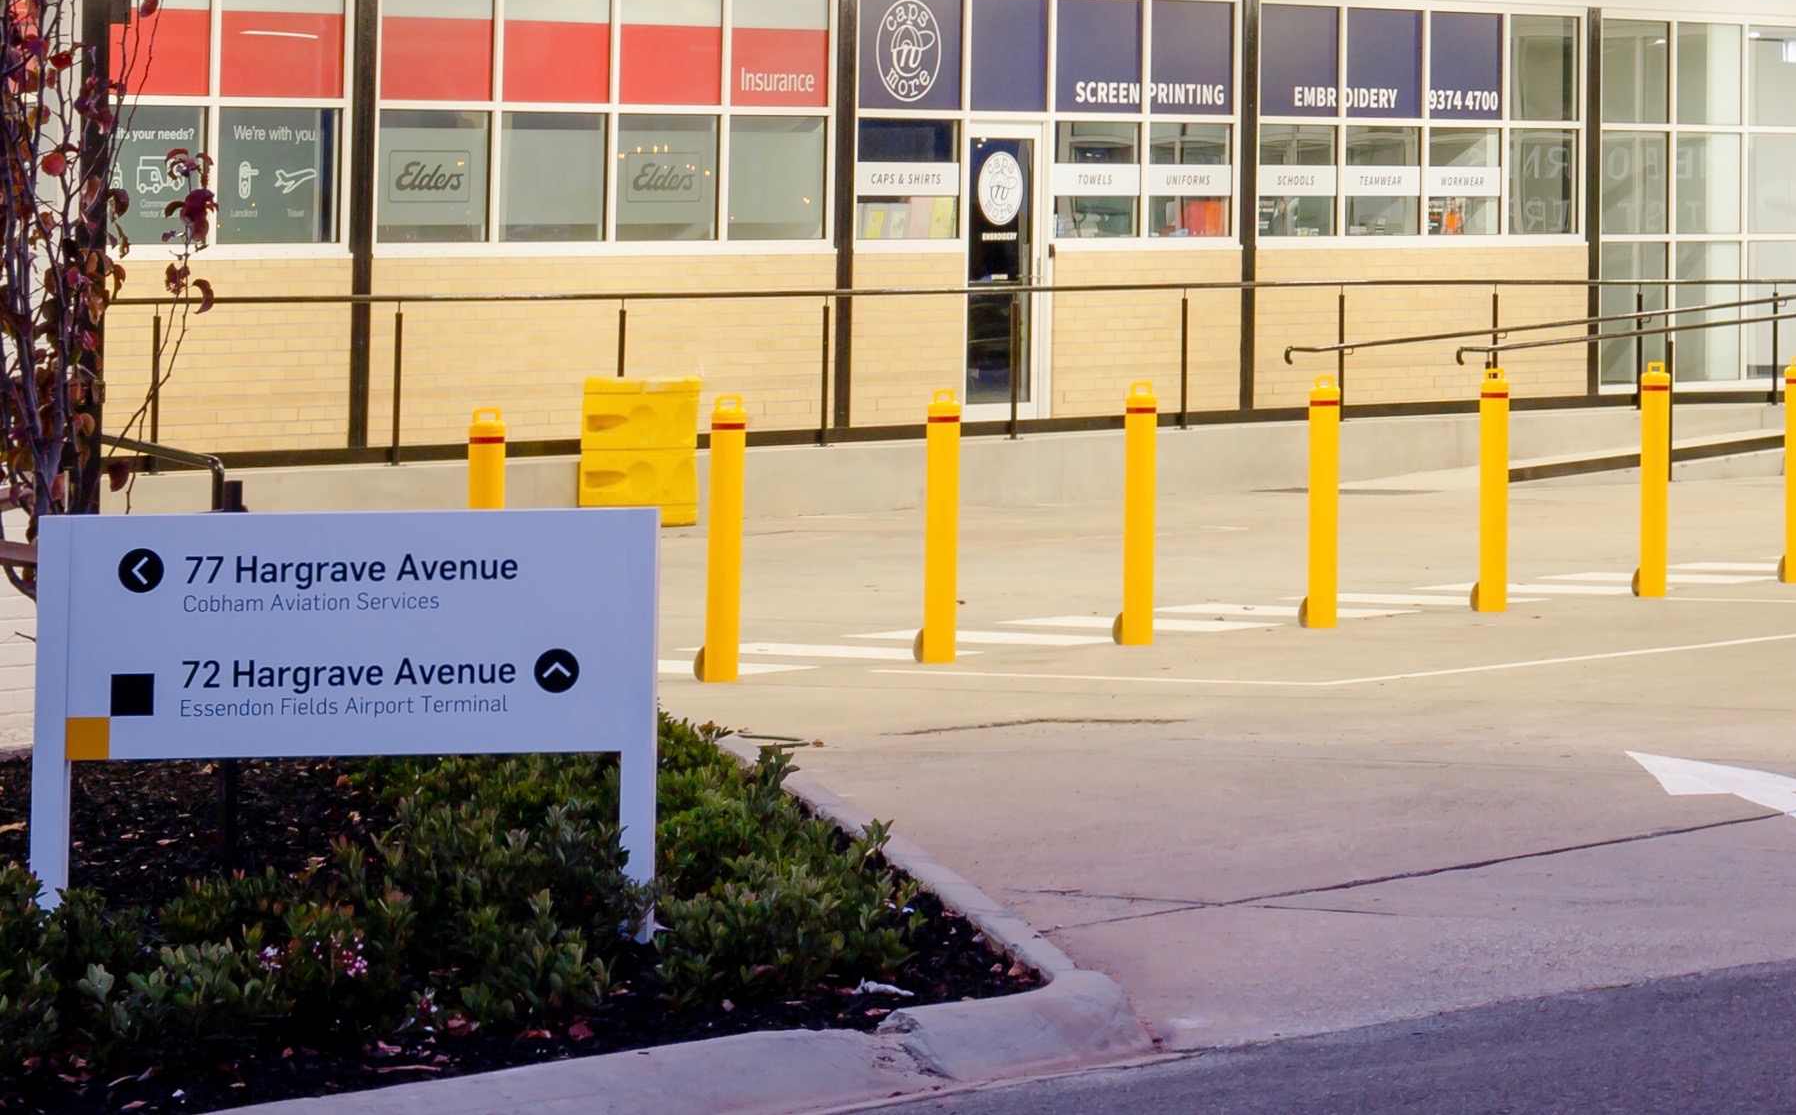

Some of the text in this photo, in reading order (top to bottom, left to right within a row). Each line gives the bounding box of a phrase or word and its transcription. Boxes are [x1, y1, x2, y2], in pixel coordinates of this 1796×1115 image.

[886, 2, 930, 32] caps
[740, 67, 815, 92] Insurance
[885, 67, 931, 97] more
[1075, 81, 1224, 105] SCREEN PRINTING
[1294, 86, 1398, 108] EMBROIDERY
[1428, 90, 1498, 111] 9374 4700
[115, 127, 195, 142] its your needs?
[233, 124, 318, 144] We're with you.
[395, 161, 464, 191] Elders
[633, 162, 695, 192] Elders
[871, 173, 942, 185] CAPS & SHIRTS
[1078, 174, 1113, 185] TOWELS
[1166, 175, 1211, 186] UNIFORMS
[1277, 175, 1315, 186] SCHOOLS
[1360, 176, 1402, 186] TEAMWEAR
[1441, 176, 1485, 186] WORKWEAR
[184, 552, 519, 590] 77 Hargrave Avenue
[182, 592, 441, 614] Cobham Aviation Services
[181, 656, 517, 695] 72 Hargrave Avenue
[179, 693, 508, 718] Essendon Fields Airport Terminal
